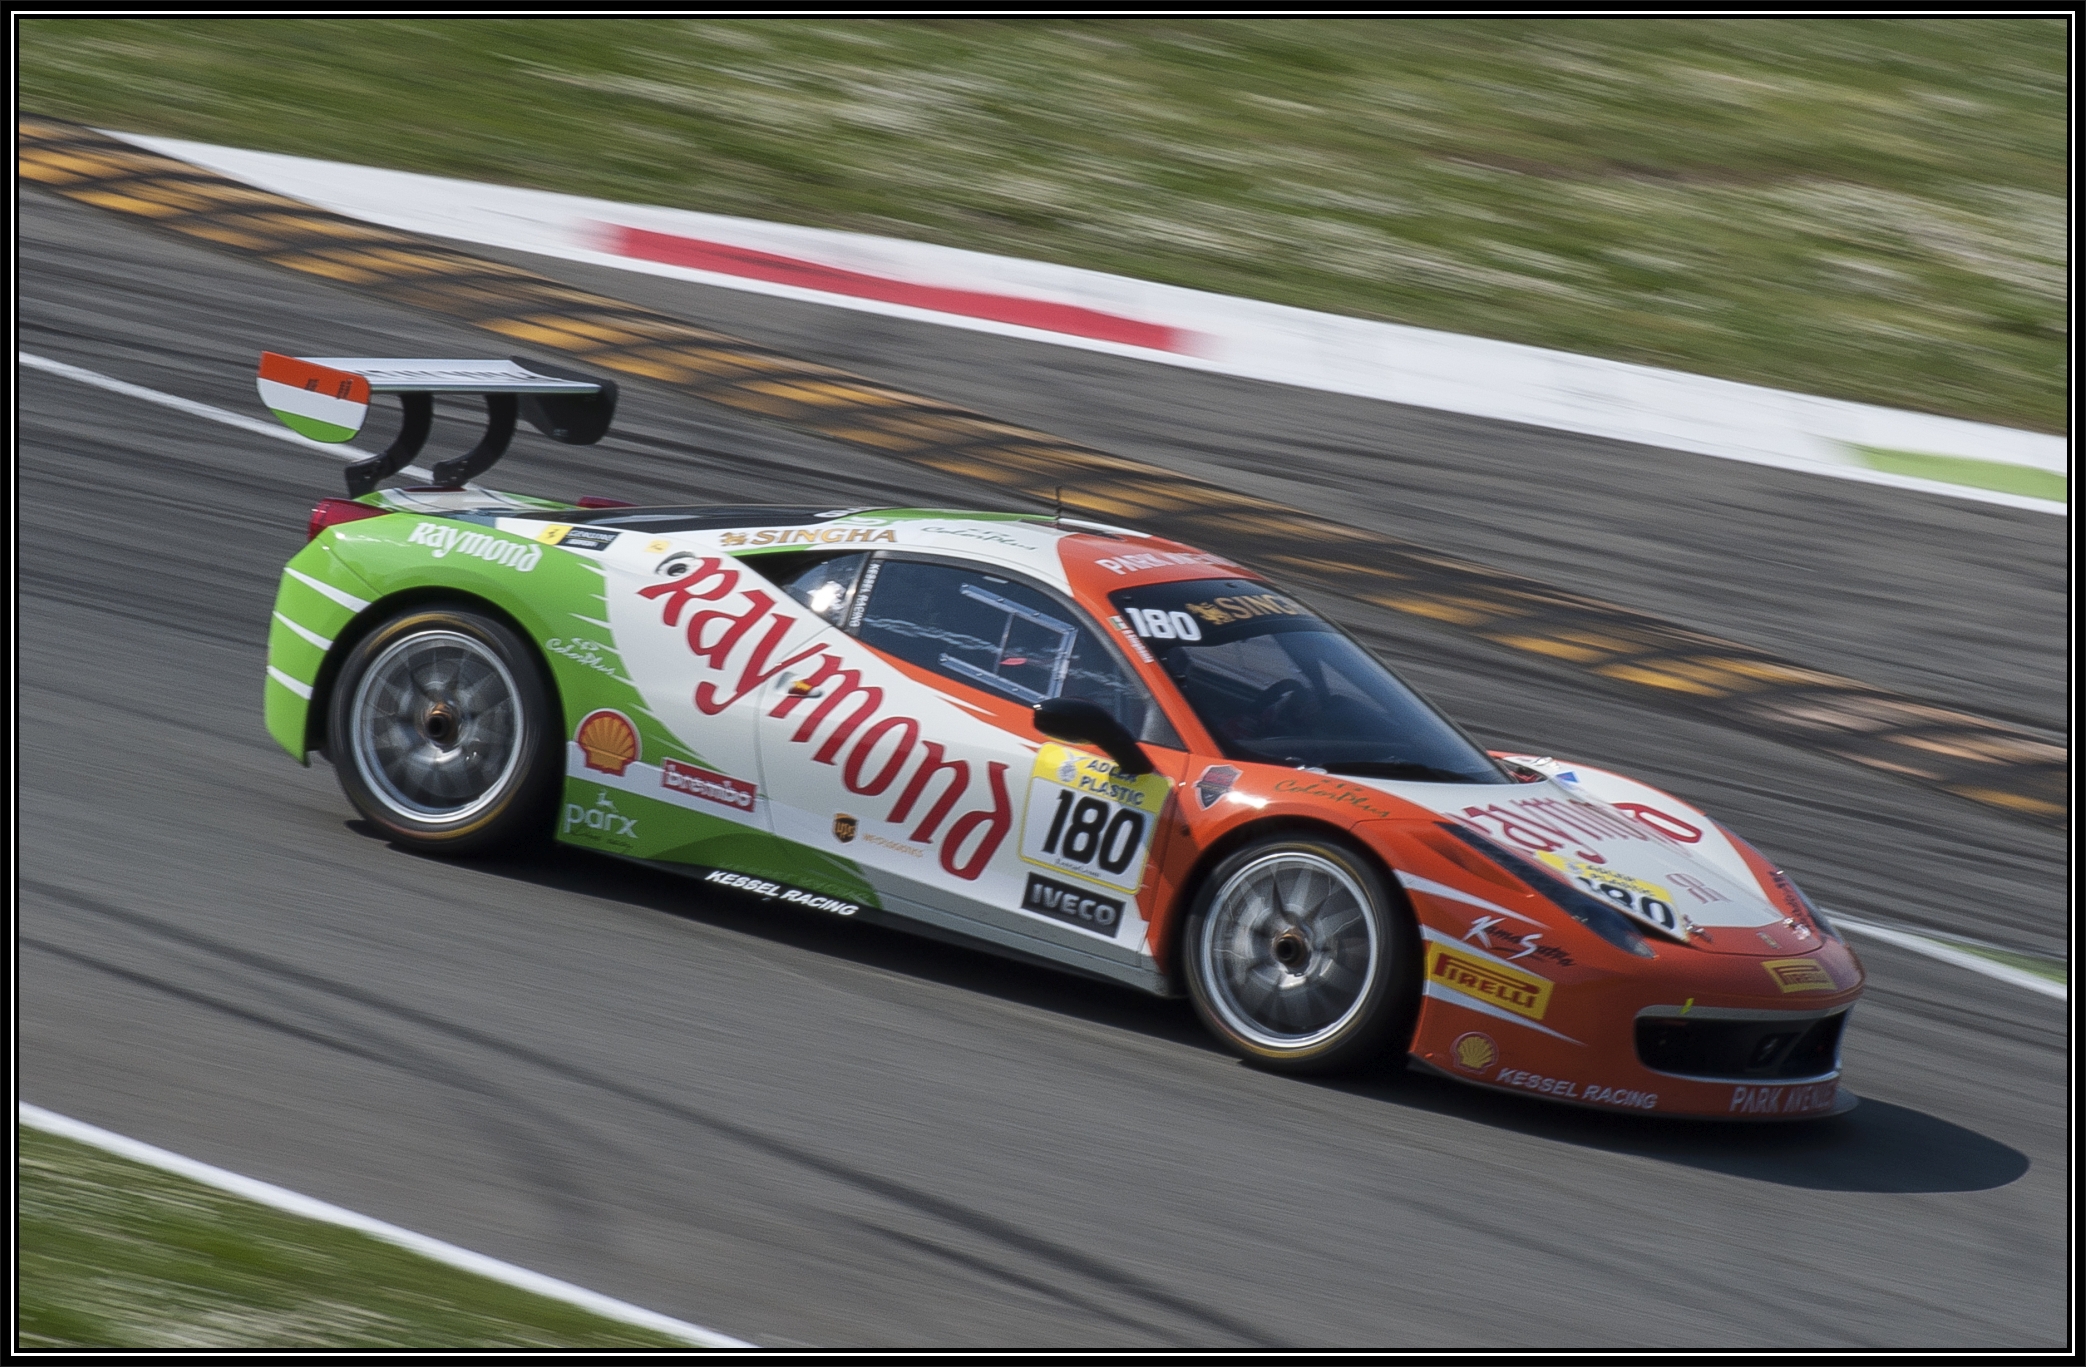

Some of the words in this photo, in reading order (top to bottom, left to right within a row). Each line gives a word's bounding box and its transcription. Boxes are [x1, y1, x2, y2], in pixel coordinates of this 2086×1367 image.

[408, 522, 543, 573] Raymond
[749, 528, 898, 545] SINGHA
[1124, 607, 1201, 641] 180
[637, 557, 1012, 881] Raymond
[667, 764, 752, 807] brembo
[1080, 775, 1145, 806] PLASTIC
[1274, 780, 1391, 818] ColorPlus
[563, 803, 638, 838] parx
[1041, 789, 1145, 875] 180
[705, 871, 780, 897] KESSEL
[779, 889, 859, 916] RACING
[1031, 883, 1117, 926] IVECO
[1433, 953, 1541, 1009] PIRELLI
[1496, 1067, 1579, 1098] KESSEL
[1582, 1084, 1659, 1110] RACING
[1729, 1086, 1784, 1113] PARK
